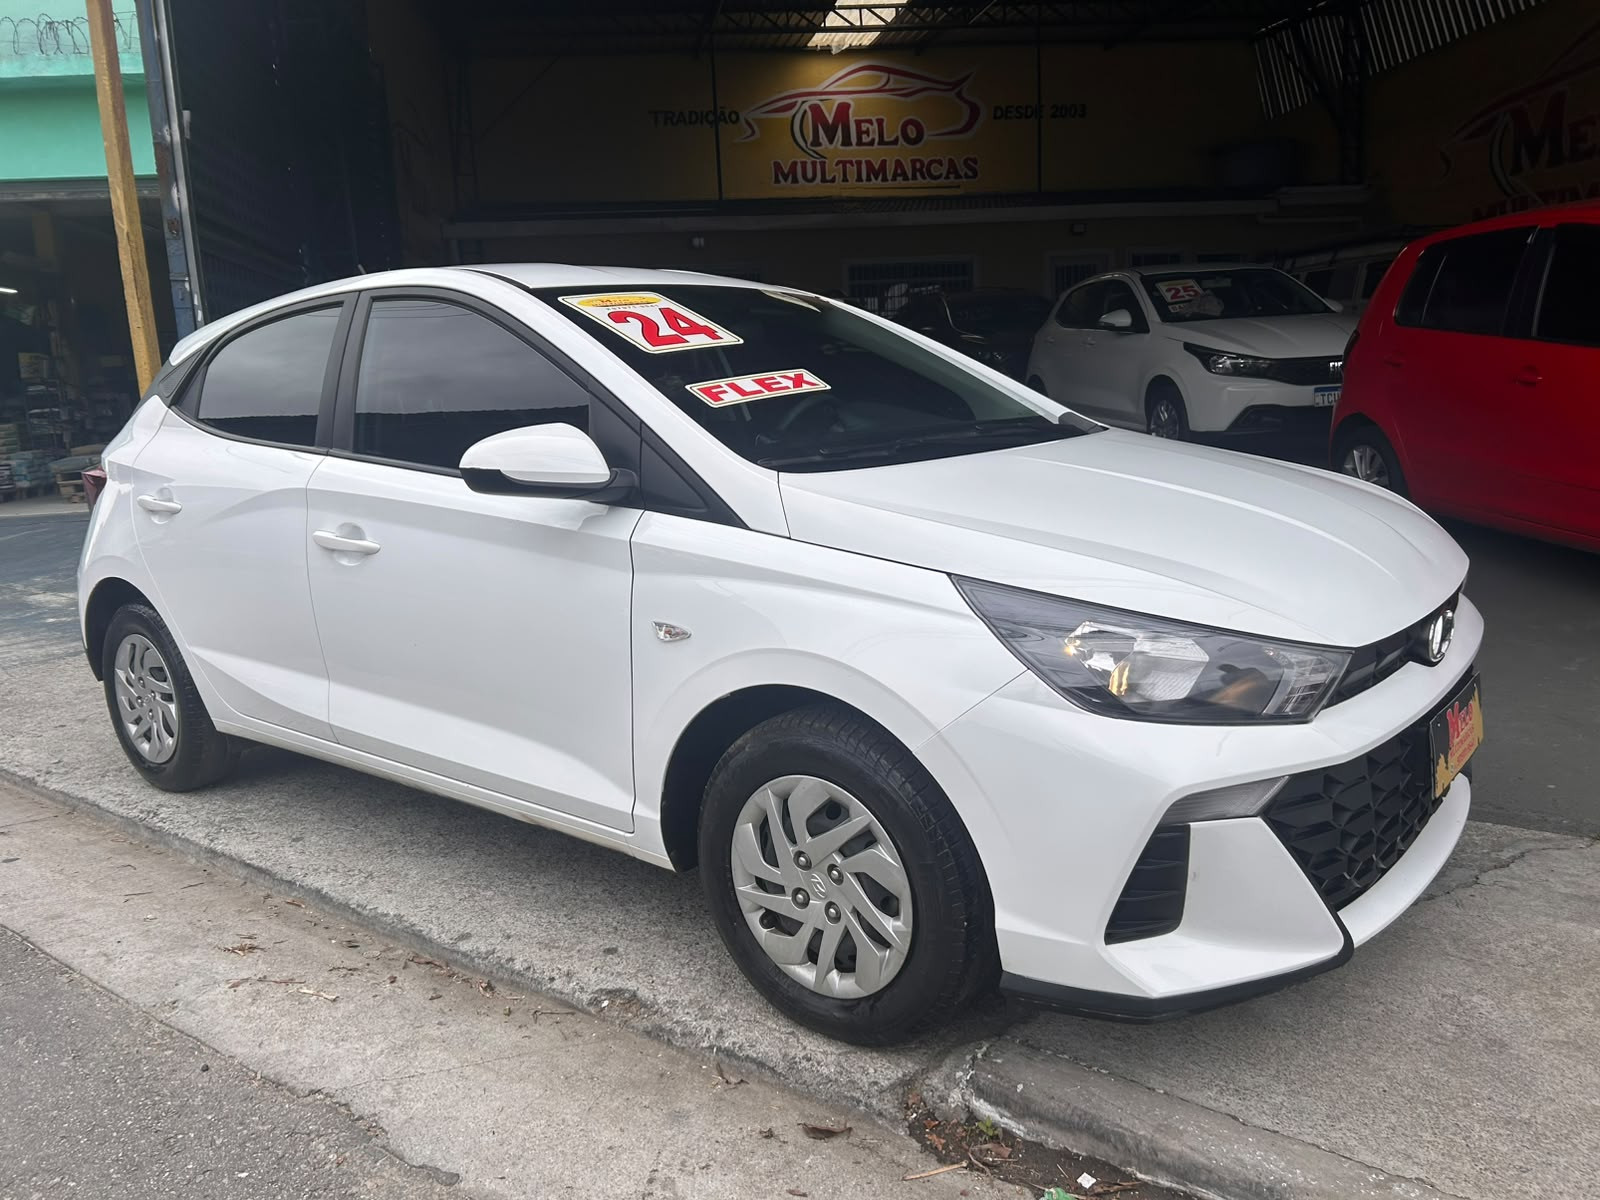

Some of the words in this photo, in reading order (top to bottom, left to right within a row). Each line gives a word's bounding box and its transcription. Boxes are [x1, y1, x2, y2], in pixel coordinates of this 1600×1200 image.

[649, 108, 740, 128] TRADIÇÃO
[993, 104, 1044, 121] DESDE
[1050, 103, 1087, 119] 2003
[808, 102, 926, 148] MELO
[771, 156, 979, 185] MULTIMARCAS
[1165, 285, 1201, 300] 25
[607, 307, 723, 347] 24
[695, 373, 821, 402] FLEX
